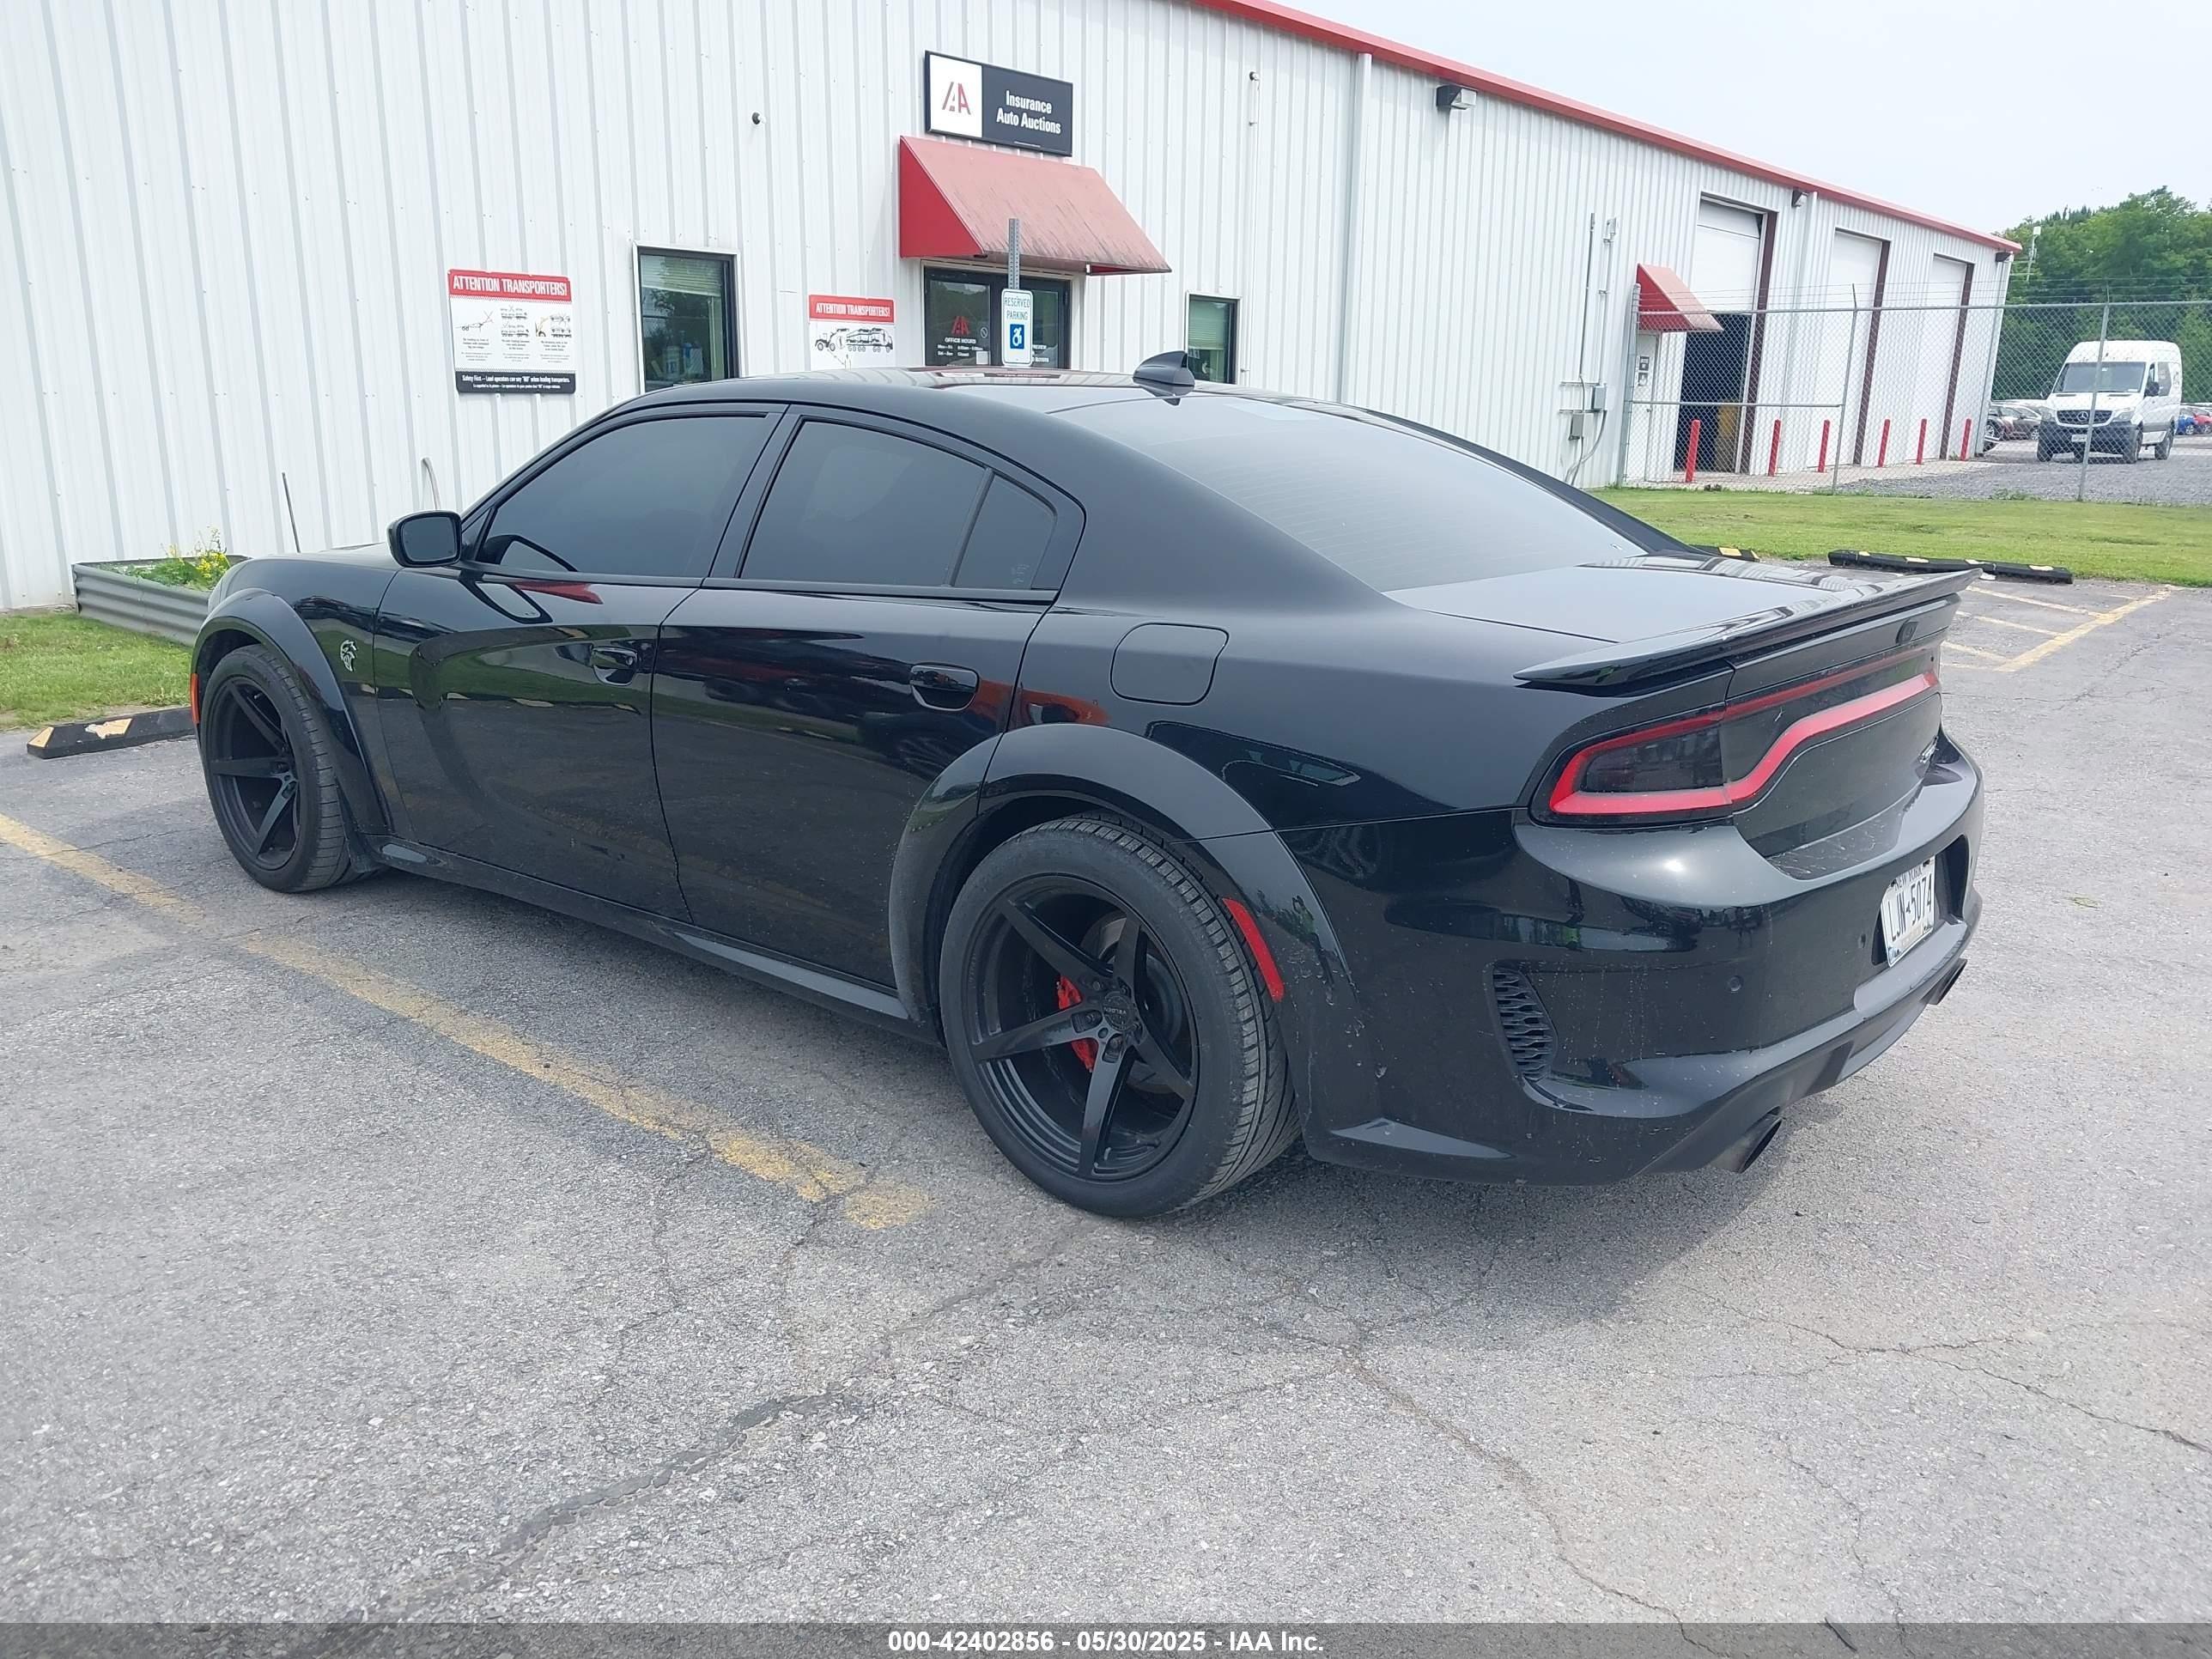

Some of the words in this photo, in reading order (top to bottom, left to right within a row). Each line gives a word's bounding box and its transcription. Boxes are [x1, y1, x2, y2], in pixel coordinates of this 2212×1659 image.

[1006, 89, 1052, 114] Insurance
[996, 107, 1019, 126] Auto
[1020, 112, 1061, 135] Auctions
[453, 275, 501, 292] ATTENTION
[501, 278, 568, 296] TRANSPORTERS!
[816, 302, 847, 314] ATTENTION
[847, 304, 890, 317] TRANSPORTERS!
[1004, 296, 1030, 308] RESERVED
[1006, 310, 1029, 320] PARKING
[1894, 872, 1908, 891] NEW
[1908, 866, 1923, 882] YORK
